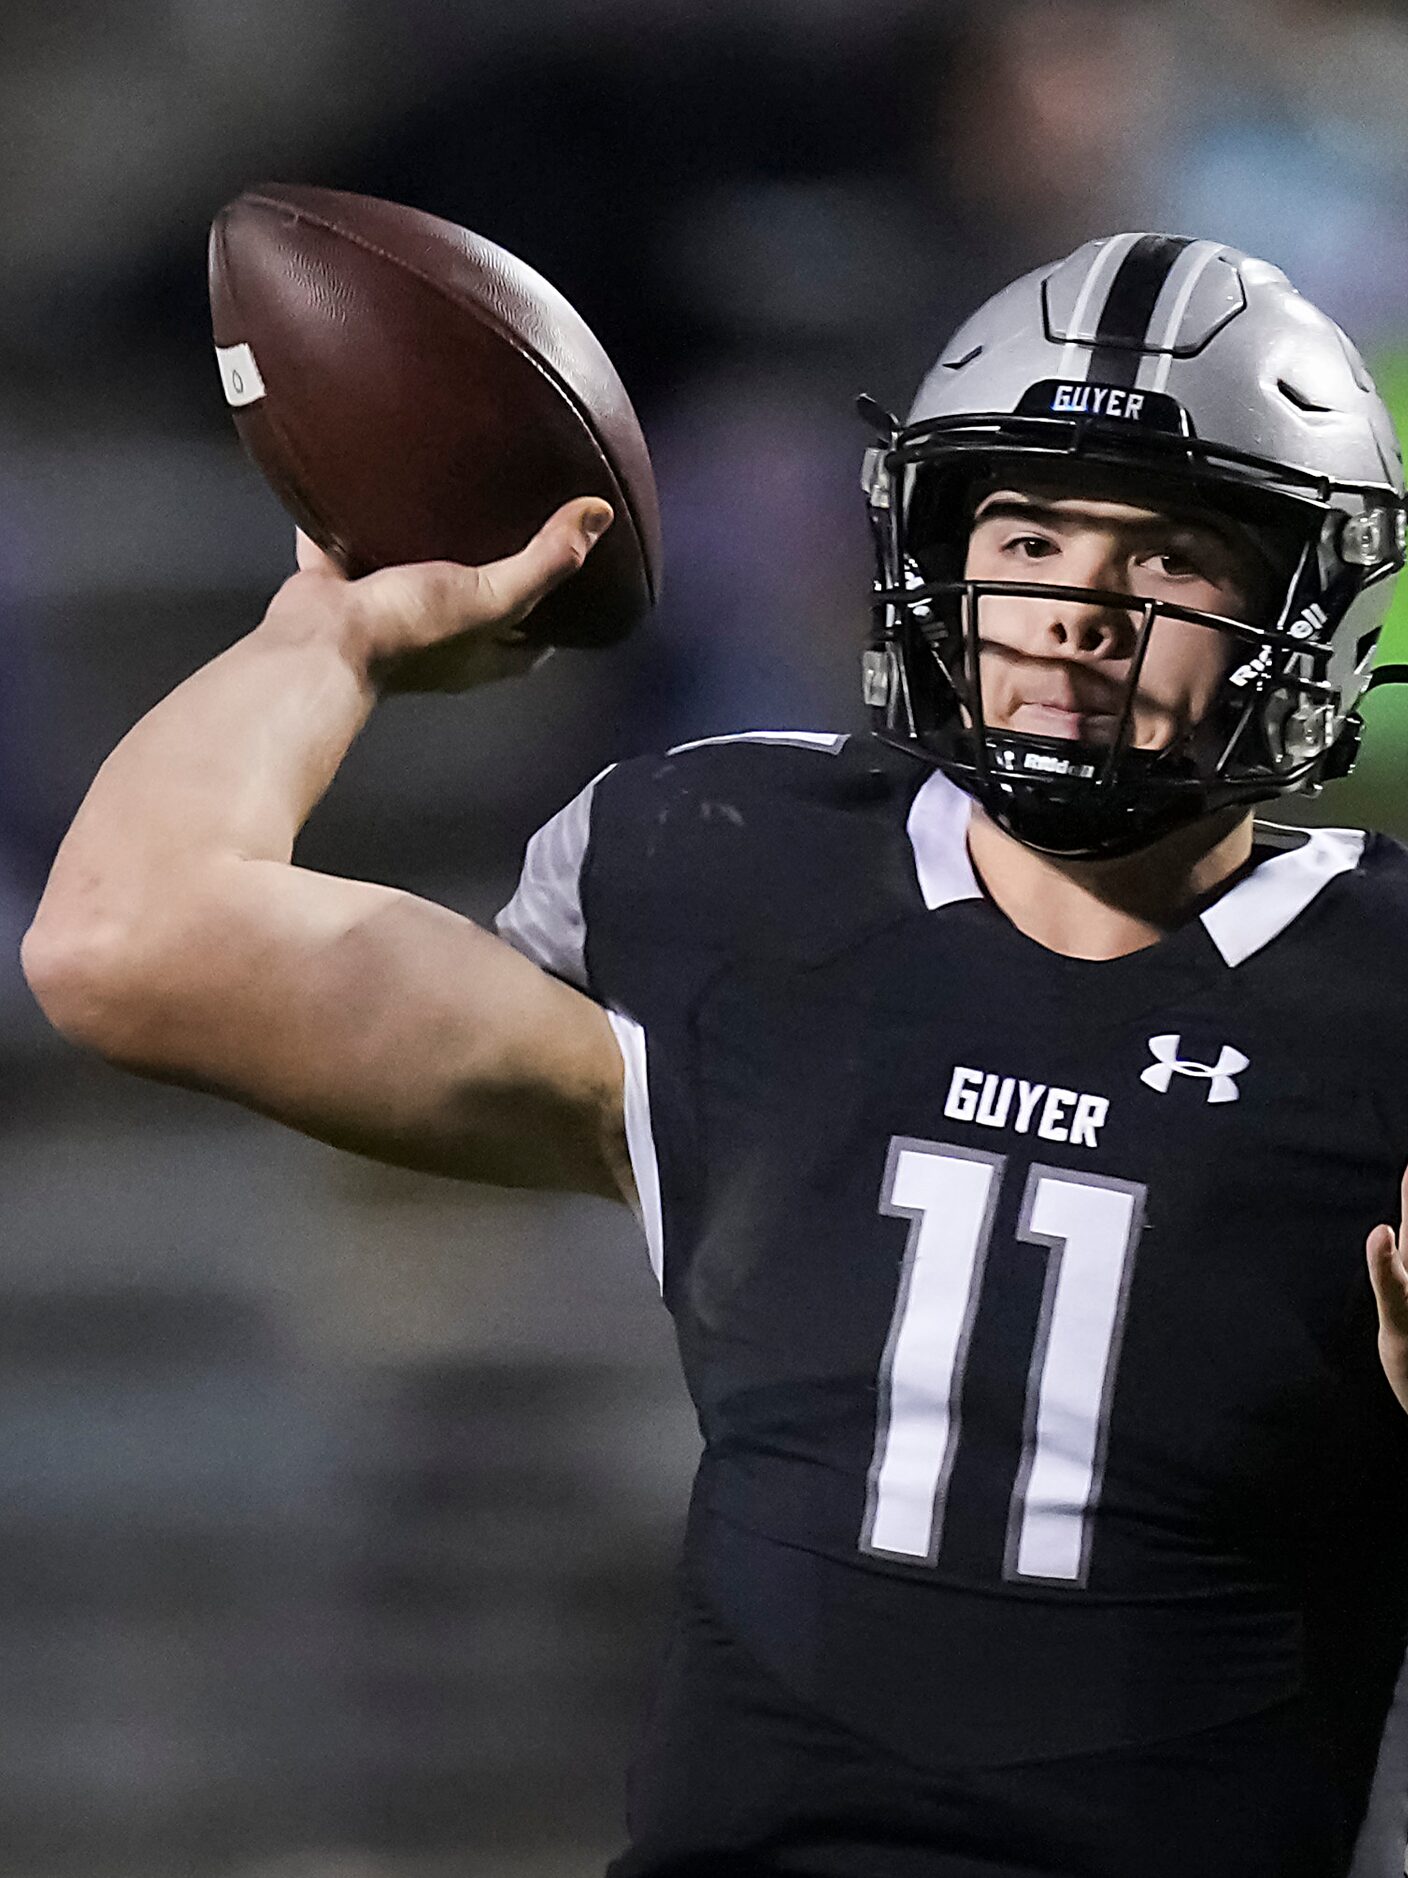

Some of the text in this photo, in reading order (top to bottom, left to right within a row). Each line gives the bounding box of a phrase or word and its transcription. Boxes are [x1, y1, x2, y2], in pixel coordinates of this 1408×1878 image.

[1051, 385, 1145, 420] GUYER
[943, 1066, 1110, 1148] GUYER
[859, 1135, 1147, 1589] 11
